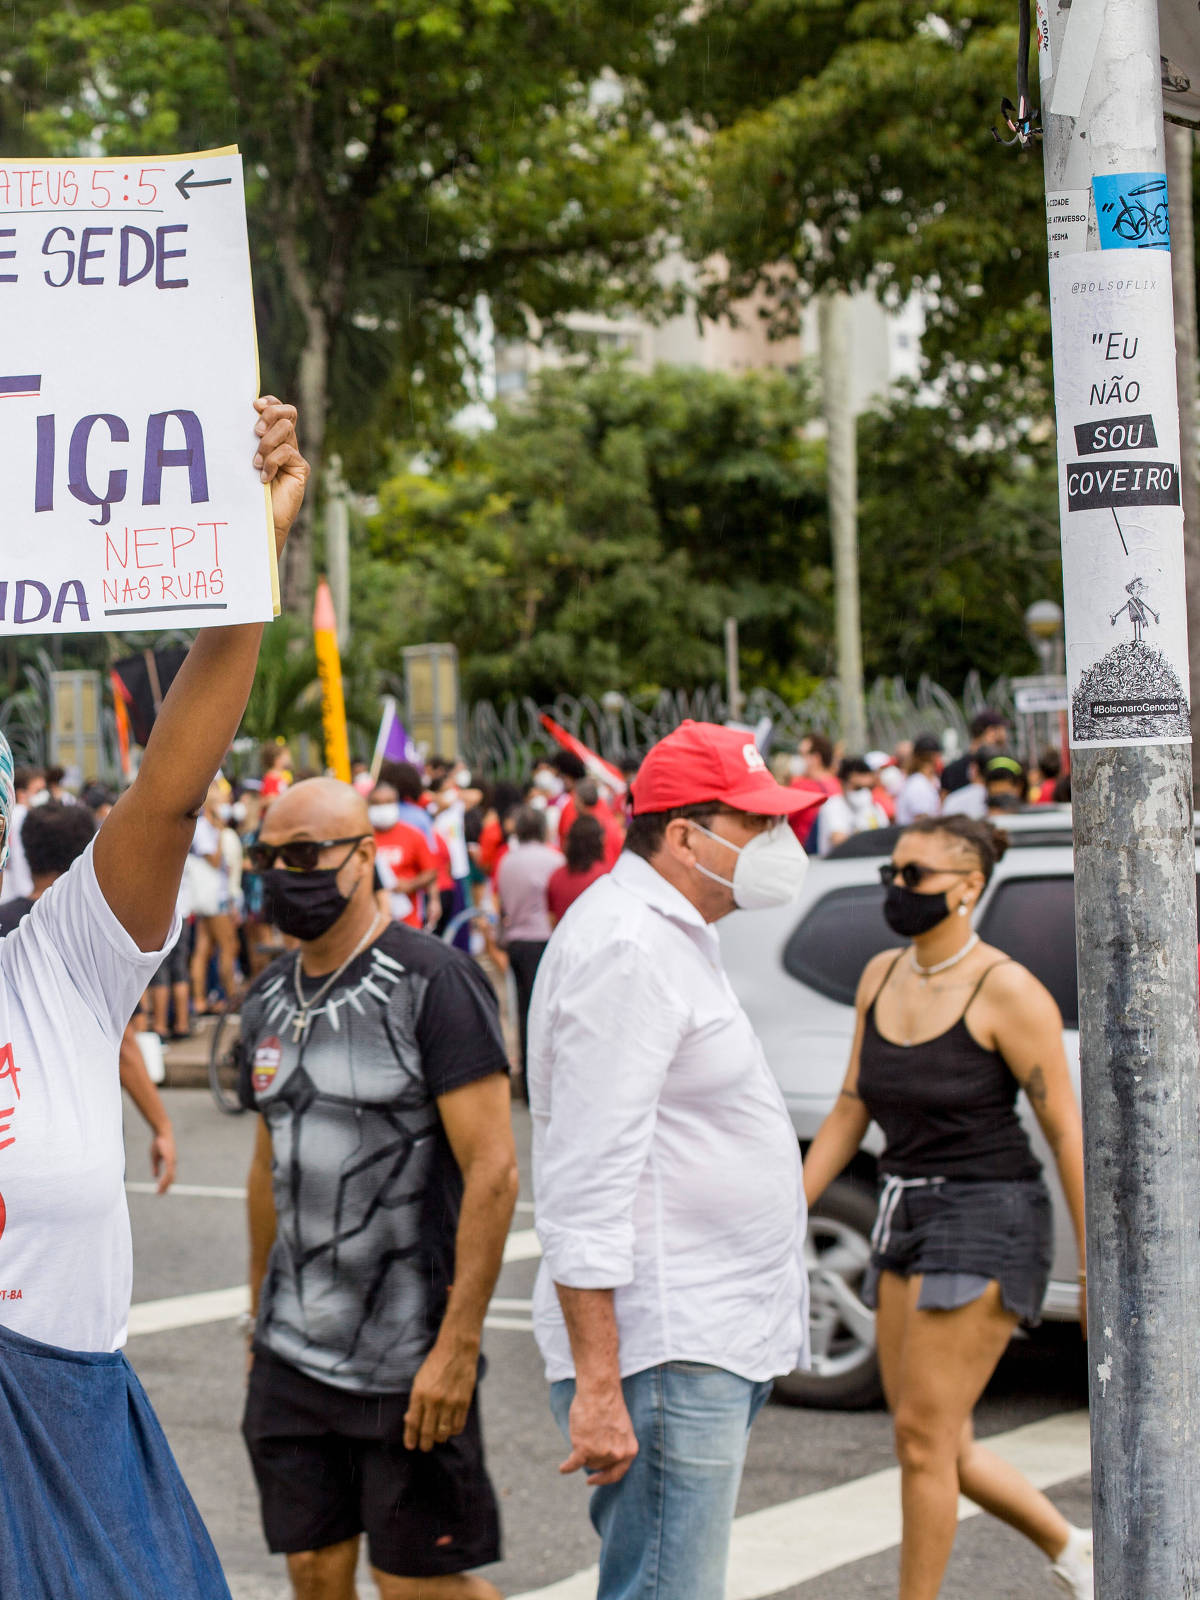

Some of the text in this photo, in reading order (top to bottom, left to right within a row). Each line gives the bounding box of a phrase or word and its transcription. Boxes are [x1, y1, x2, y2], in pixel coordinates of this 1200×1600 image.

[90, 168, 166, 208] 5:5
[41, 224, 189, 290] SEDE
[1071, 280, 1158, 295] @BOLSOFLIX
[1089, 375, 1141, 406] NÃO
[1092, 424, 1144, 450] SOU
[105, 522, 229, 571] NEPT
[103, 568, 224, 604] NAS RUAS
[1093, 702, 1179, 714] #BolsonaroGenocida
